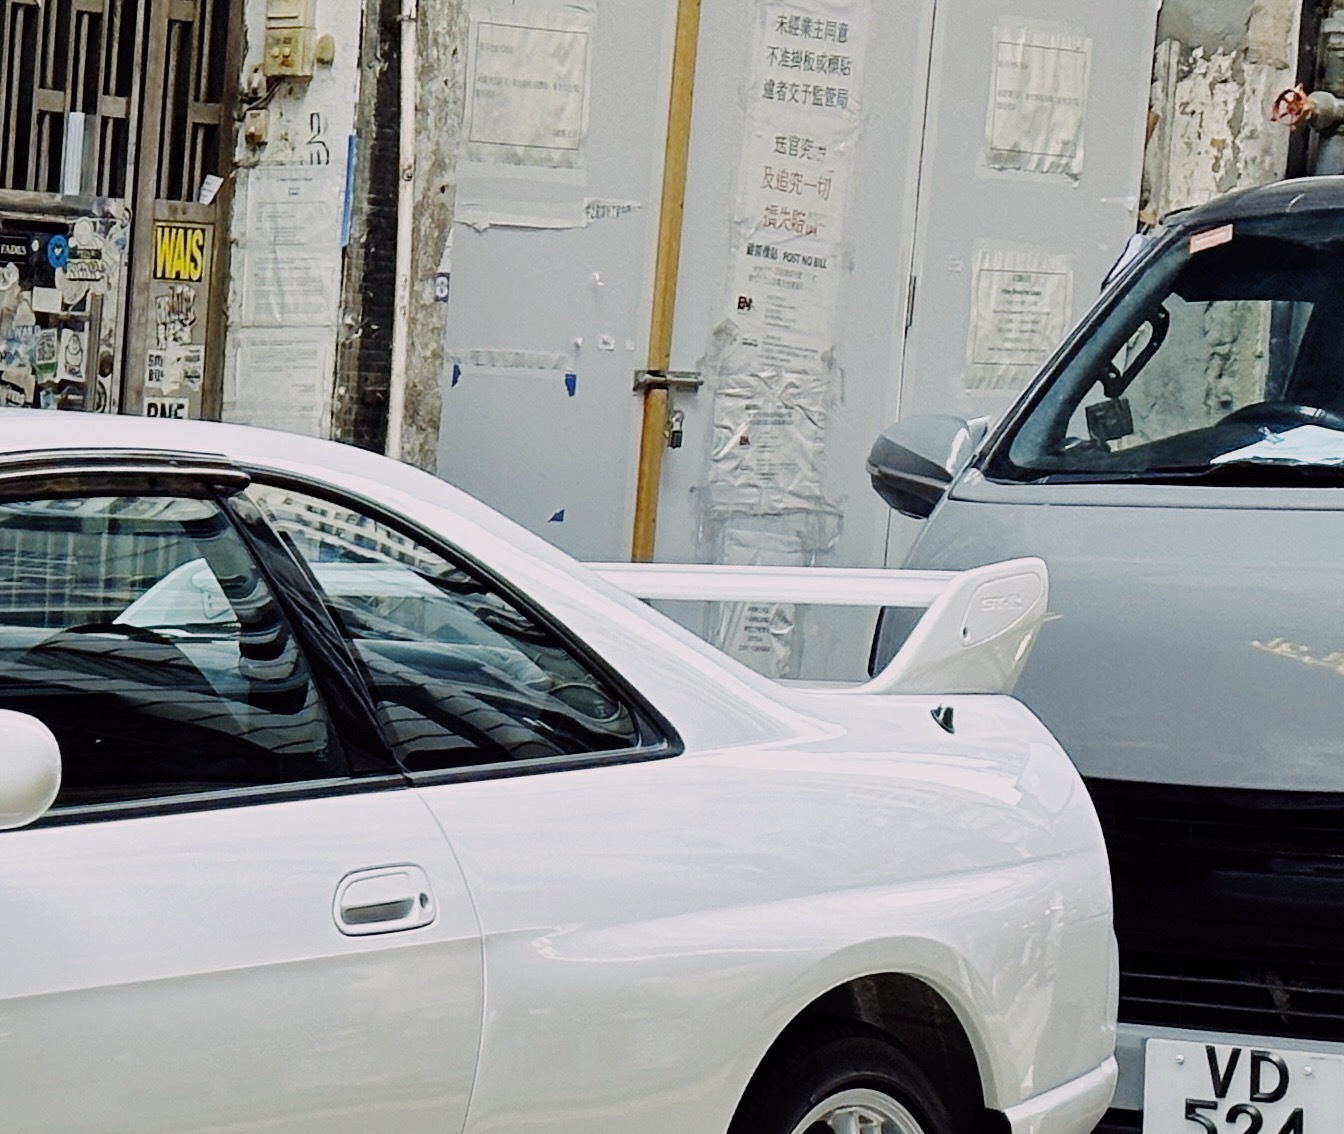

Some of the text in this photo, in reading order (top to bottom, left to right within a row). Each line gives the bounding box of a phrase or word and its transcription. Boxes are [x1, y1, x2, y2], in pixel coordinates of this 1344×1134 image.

[156, 228, 204, 281] WAIS
[782, 251, 801, 264] POST
[802, 256, 813, 267] NO
[813, 258, 827, 269] BILL
[1205, 1045, 1290, 1103] VD
